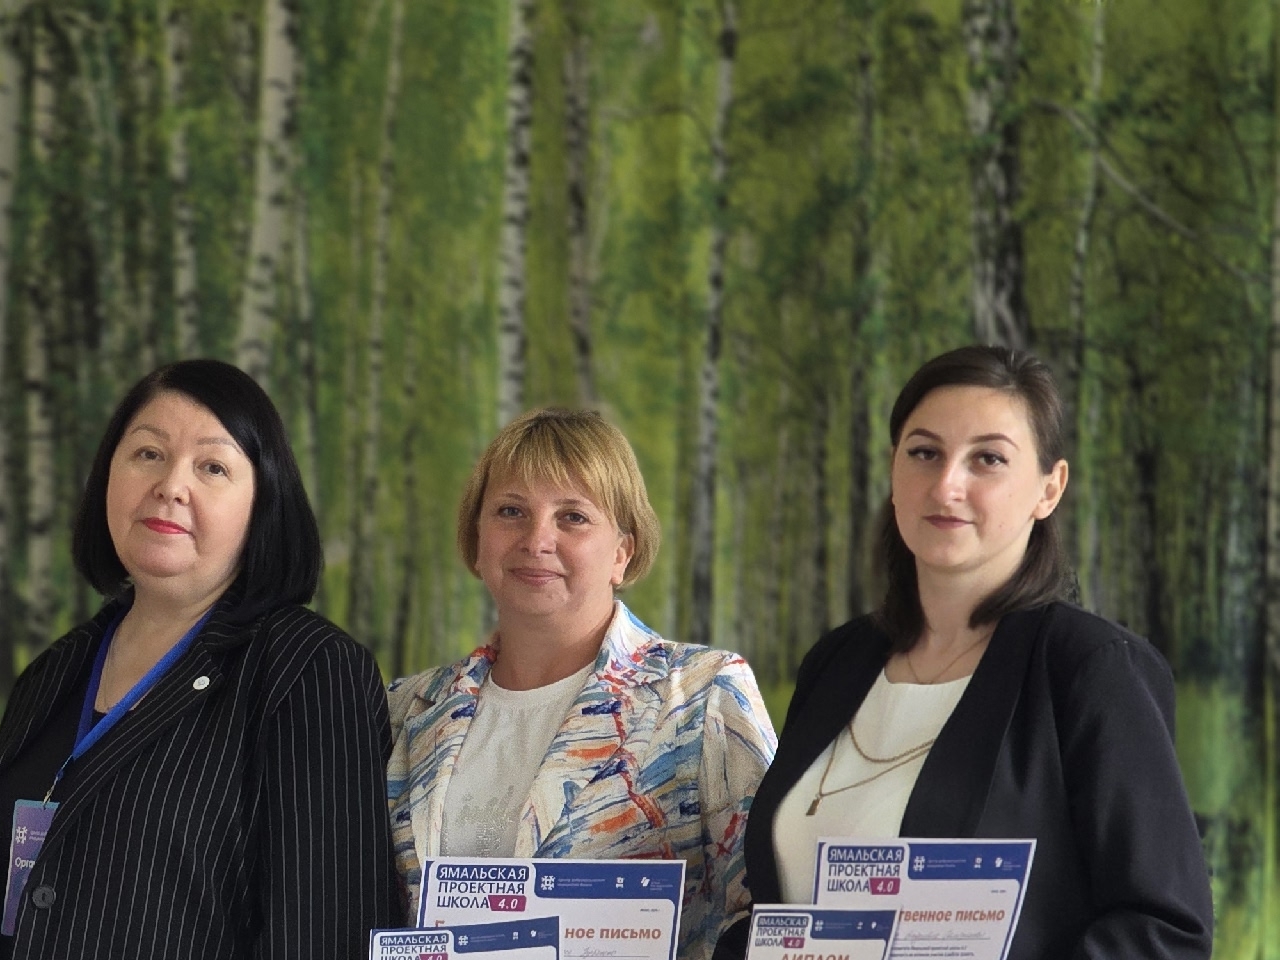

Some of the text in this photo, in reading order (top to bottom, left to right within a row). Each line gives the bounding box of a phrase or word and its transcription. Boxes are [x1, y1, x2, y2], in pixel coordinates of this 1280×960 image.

[829, 848, 903, 861] ЯМАЛЬСКАЯ
[439, 867, 526, 880] ЯМАЛЬСКАЯ
[828, 864, 900, 876] ПРОЕКТНАЯ
[438, 881, 525, 894] ПРОЕКТНАЯ
[827, 879, 894, 892] ШКОЛА 4.0
[436, 895, 518, 909] ШКОЛА 4.0
[955, 909, 1005, 922] письмо
[380, 934, 447, 946] ЯМАЛЬСКАЯ
[599, 927, 662, 940] письмо
[380, 945, 447, 954] ПРОЕКТНАЯ
